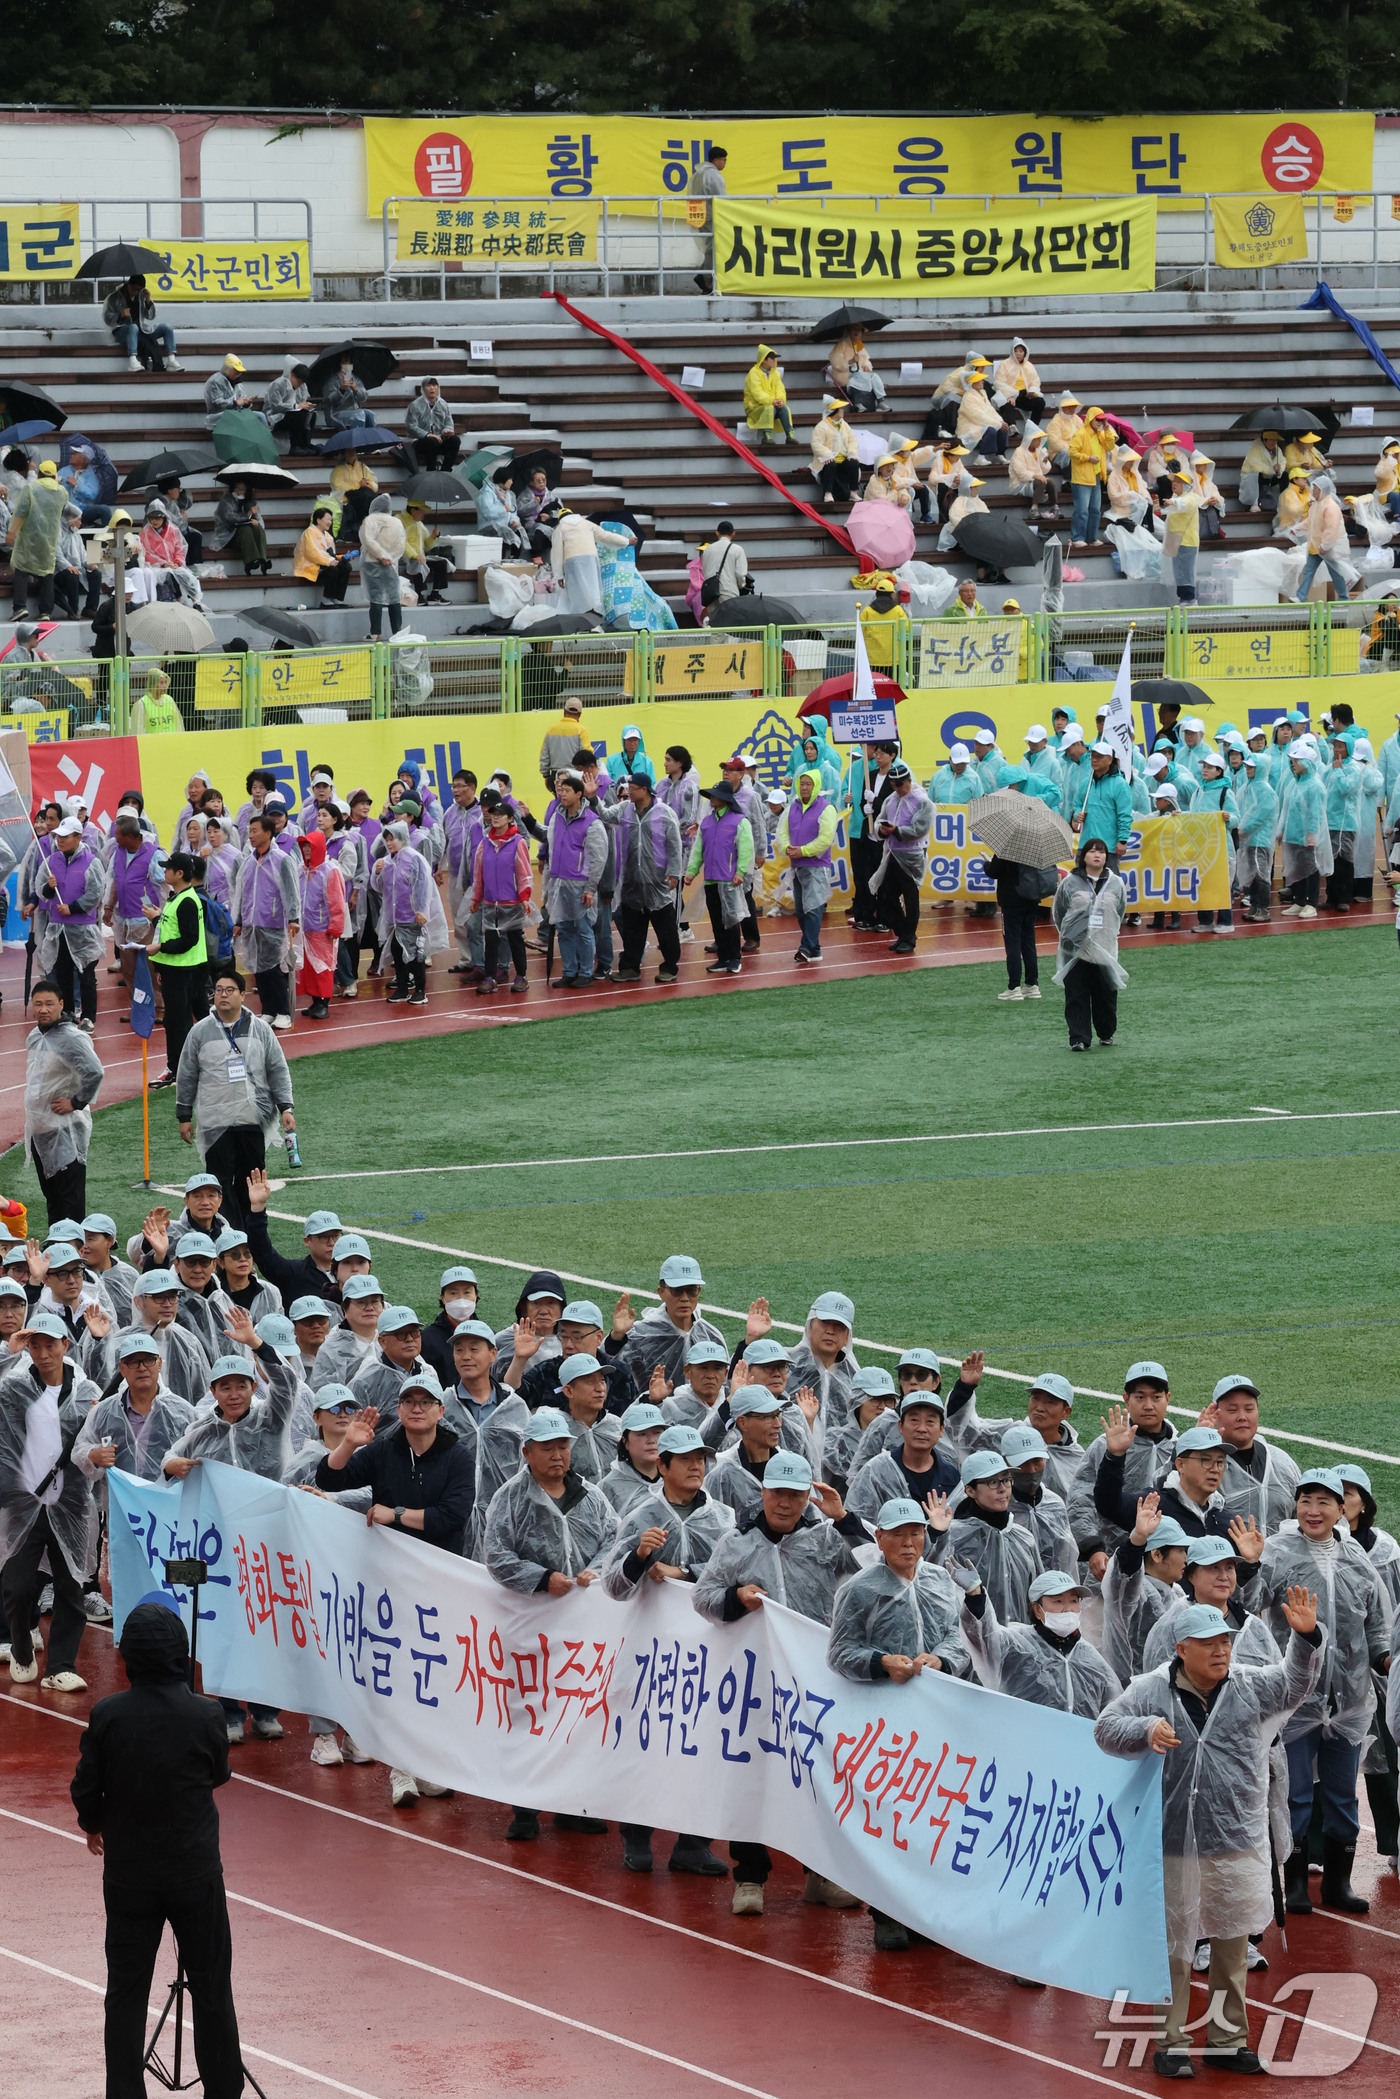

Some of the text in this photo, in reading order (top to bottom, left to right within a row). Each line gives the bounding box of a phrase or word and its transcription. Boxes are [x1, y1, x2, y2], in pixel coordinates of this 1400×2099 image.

[425, 144, 463, 195] 필
[1271, 136, 1313, 184] 승
[410, 231, 587, 257] 長淵郡 中央郡民會
[724, 219, 1131, 280] 사리원시 중앙시민회
[157, 250, 302, 292] 봉산군민회
[221, 659, 345, 693] 수안군
[149, 714, 175, 727] STAF
[838, 714, 887, 727] 미수복강원도
[850, 727, 875, 739] 선수단
[930, 856, 998, 894] 영원
[232, 1533, 327, 1661] 평화통일
[319, 1572, 402, 1698] 기반을
[410, 1603, 448, 1708] 둔
[630, 1637, 711, 1758] 강력한
[832, 1717, 997, 1876] 대한민국을
